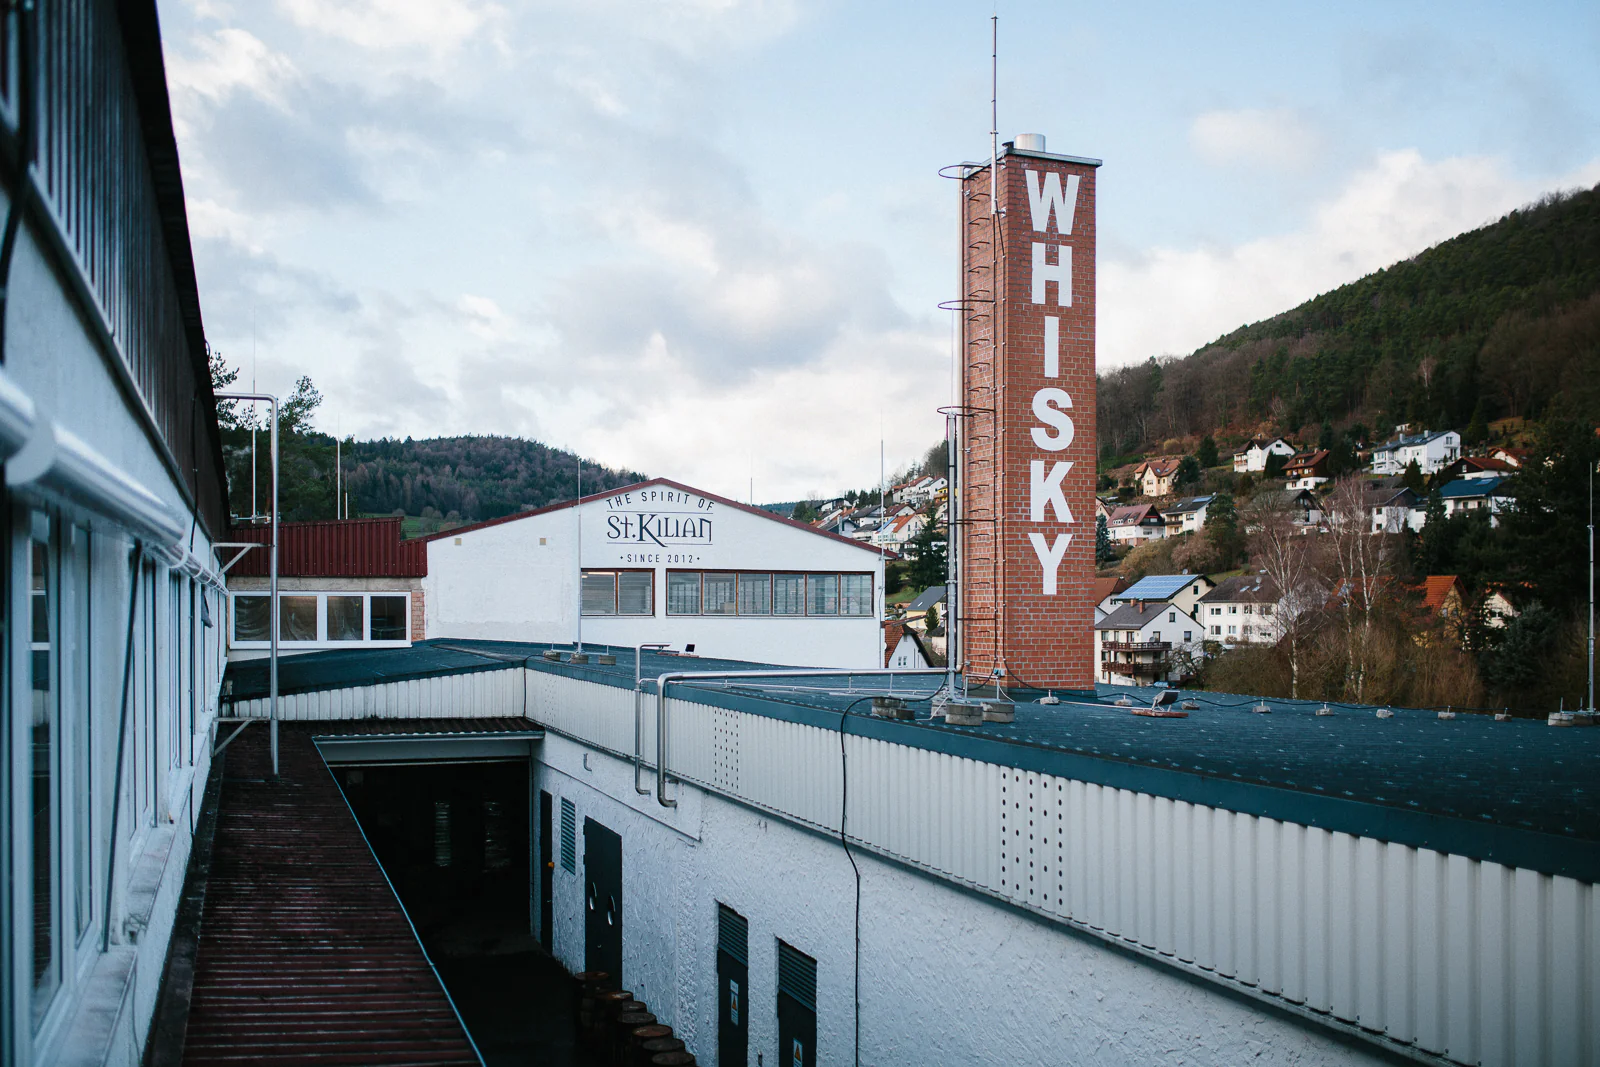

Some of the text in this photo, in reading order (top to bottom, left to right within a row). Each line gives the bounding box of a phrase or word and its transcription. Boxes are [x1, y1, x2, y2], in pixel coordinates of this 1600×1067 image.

[1024, 169, 1081, 595] WHISKY
[606, 491, 715, 511] THE SPIRIT OF
[627, 553, 693, 563] SINCE 2012
